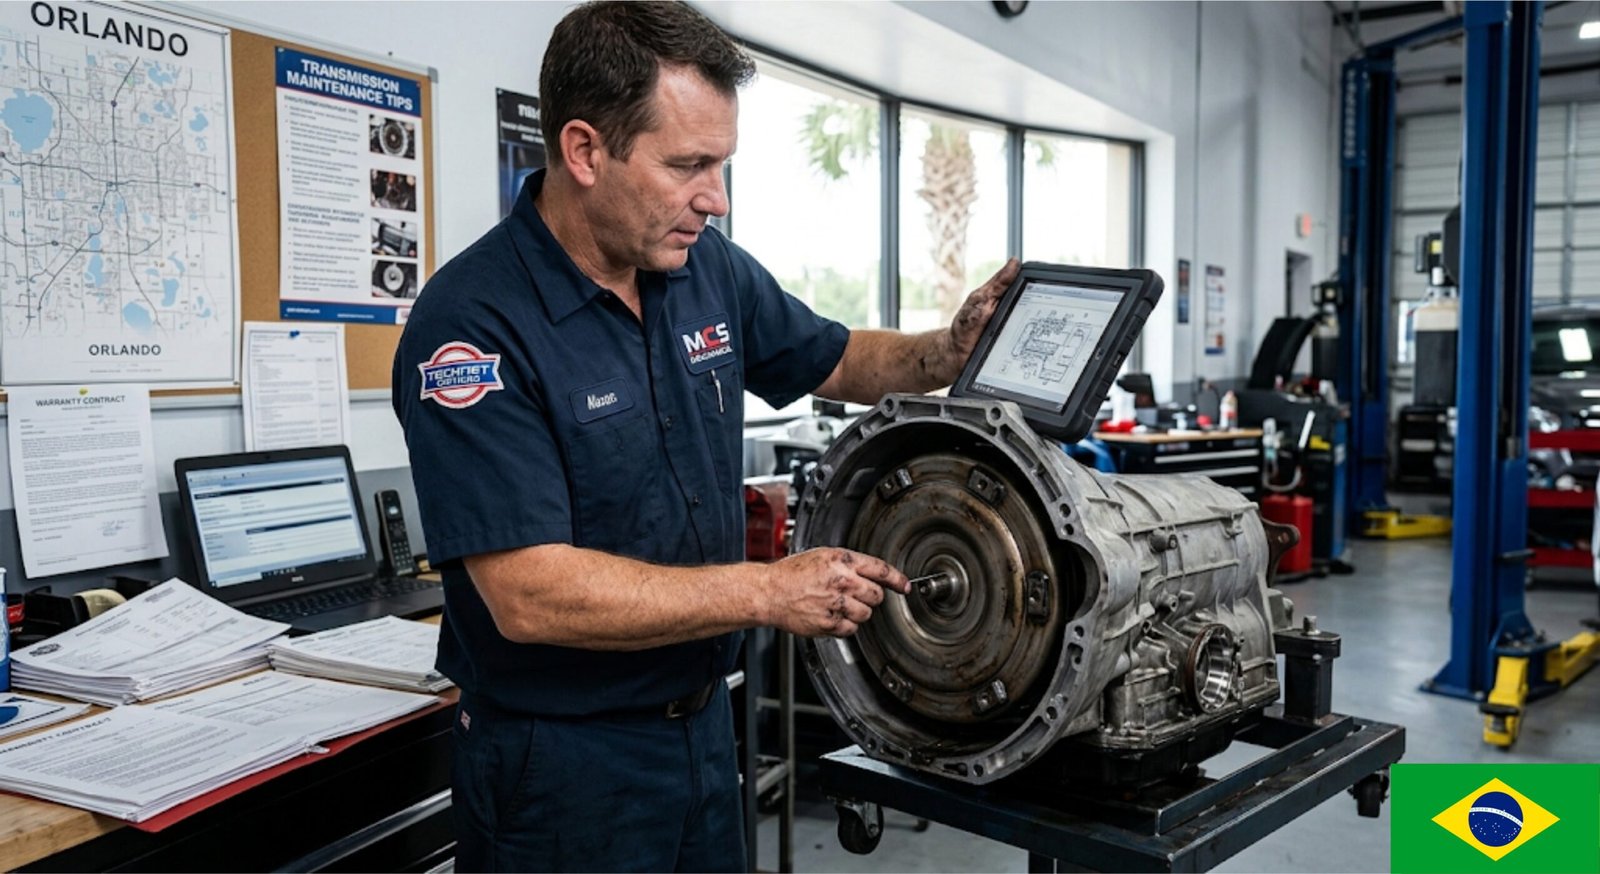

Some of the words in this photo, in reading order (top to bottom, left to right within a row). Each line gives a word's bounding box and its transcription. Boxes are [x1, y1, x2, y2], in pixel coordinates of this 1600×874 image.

[31, 1, 189, 57] ORLANDO
[286, 70, 384, 105] MAINTENANCE
[385, 93, 413, 111] TIPS
[301, 59, 400, 94] TRANSMISSION
[88, 344, 162, 356] ORLANDO
[682, 322, 730, 352] MCS
[35, 397, 81, 407] WARRANTY
[82, 395, 125, 404] CONTRACT
